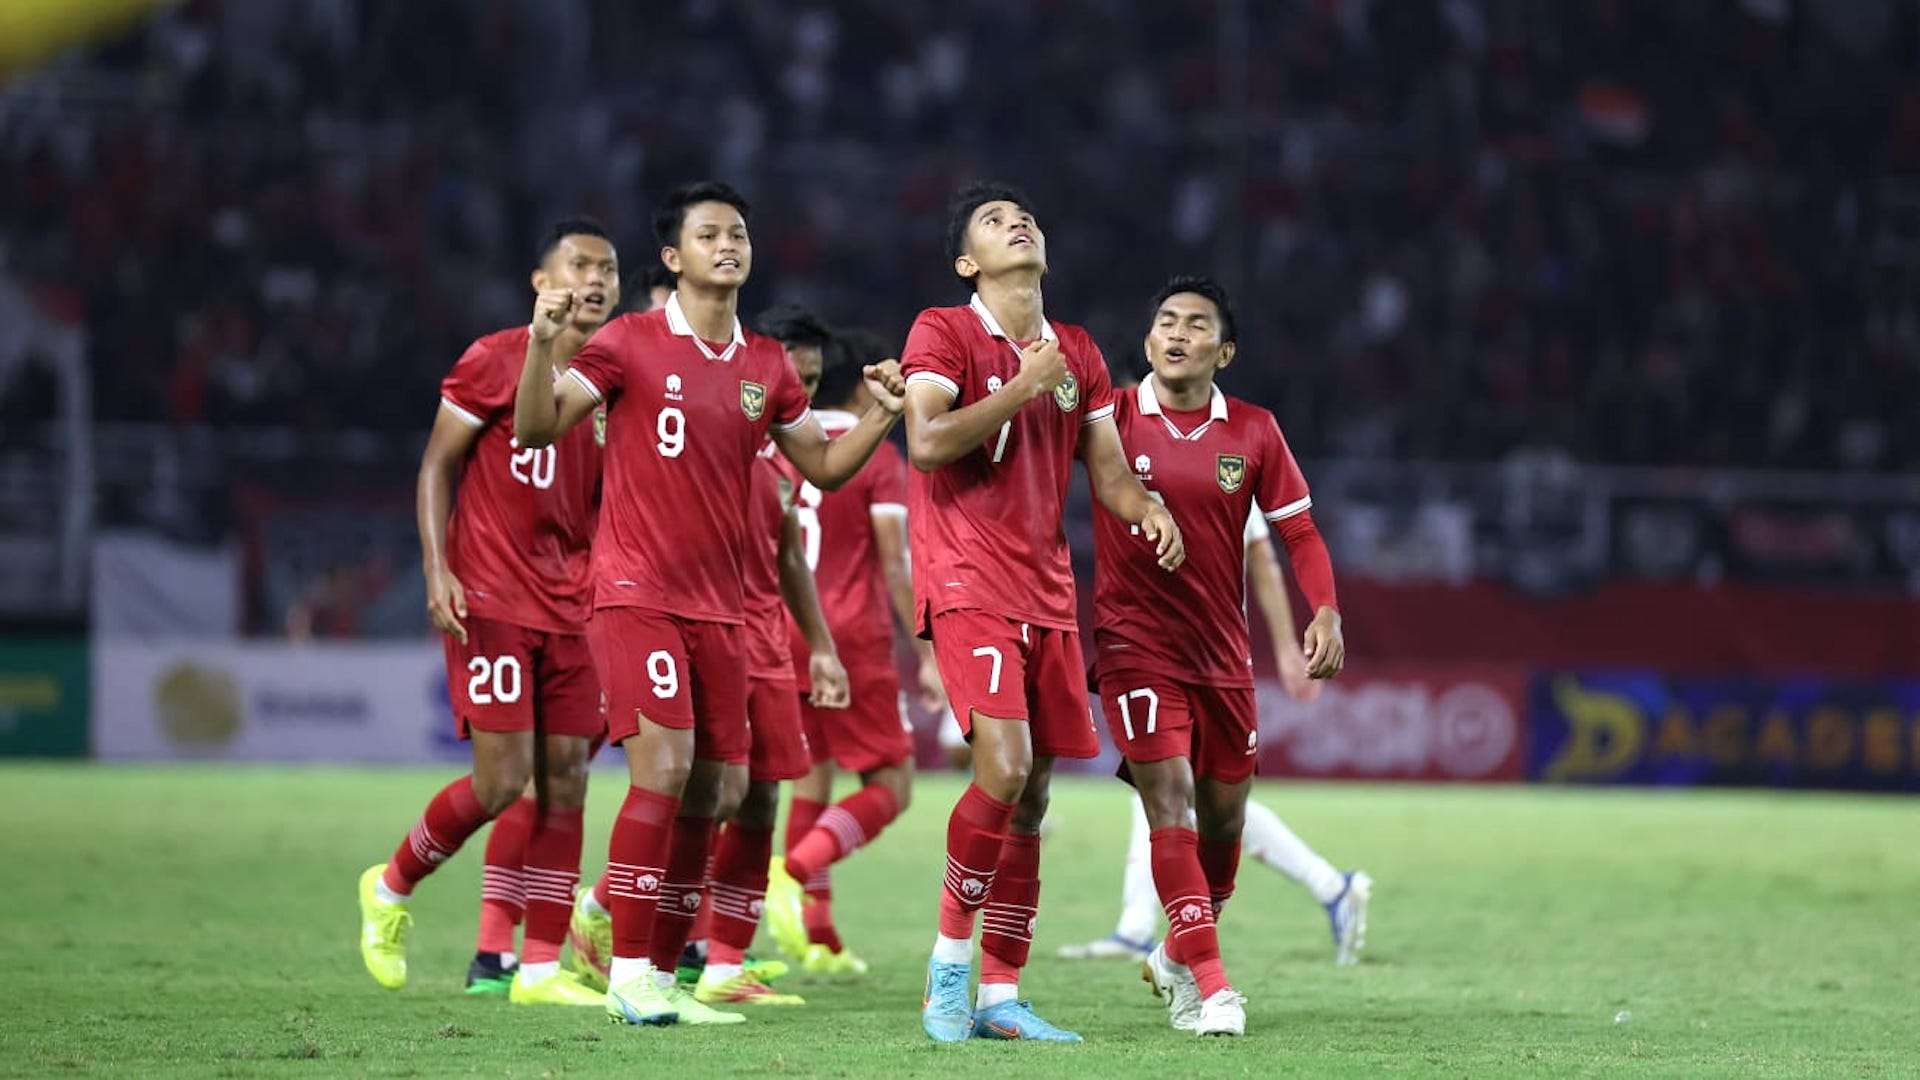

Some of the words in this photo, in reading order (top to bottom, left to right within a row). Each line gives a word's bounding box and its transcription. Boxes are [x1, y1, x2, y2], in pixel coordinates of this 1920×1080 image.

[656, 406, 686, 458] 9
[509, 436, 557, 489] 20
[467, 655, 522, 704] 20
[646, 650, 679, 699] 9
[972, 646, 1003, 694] 7
[1116, 687, 1160, 741] 17
